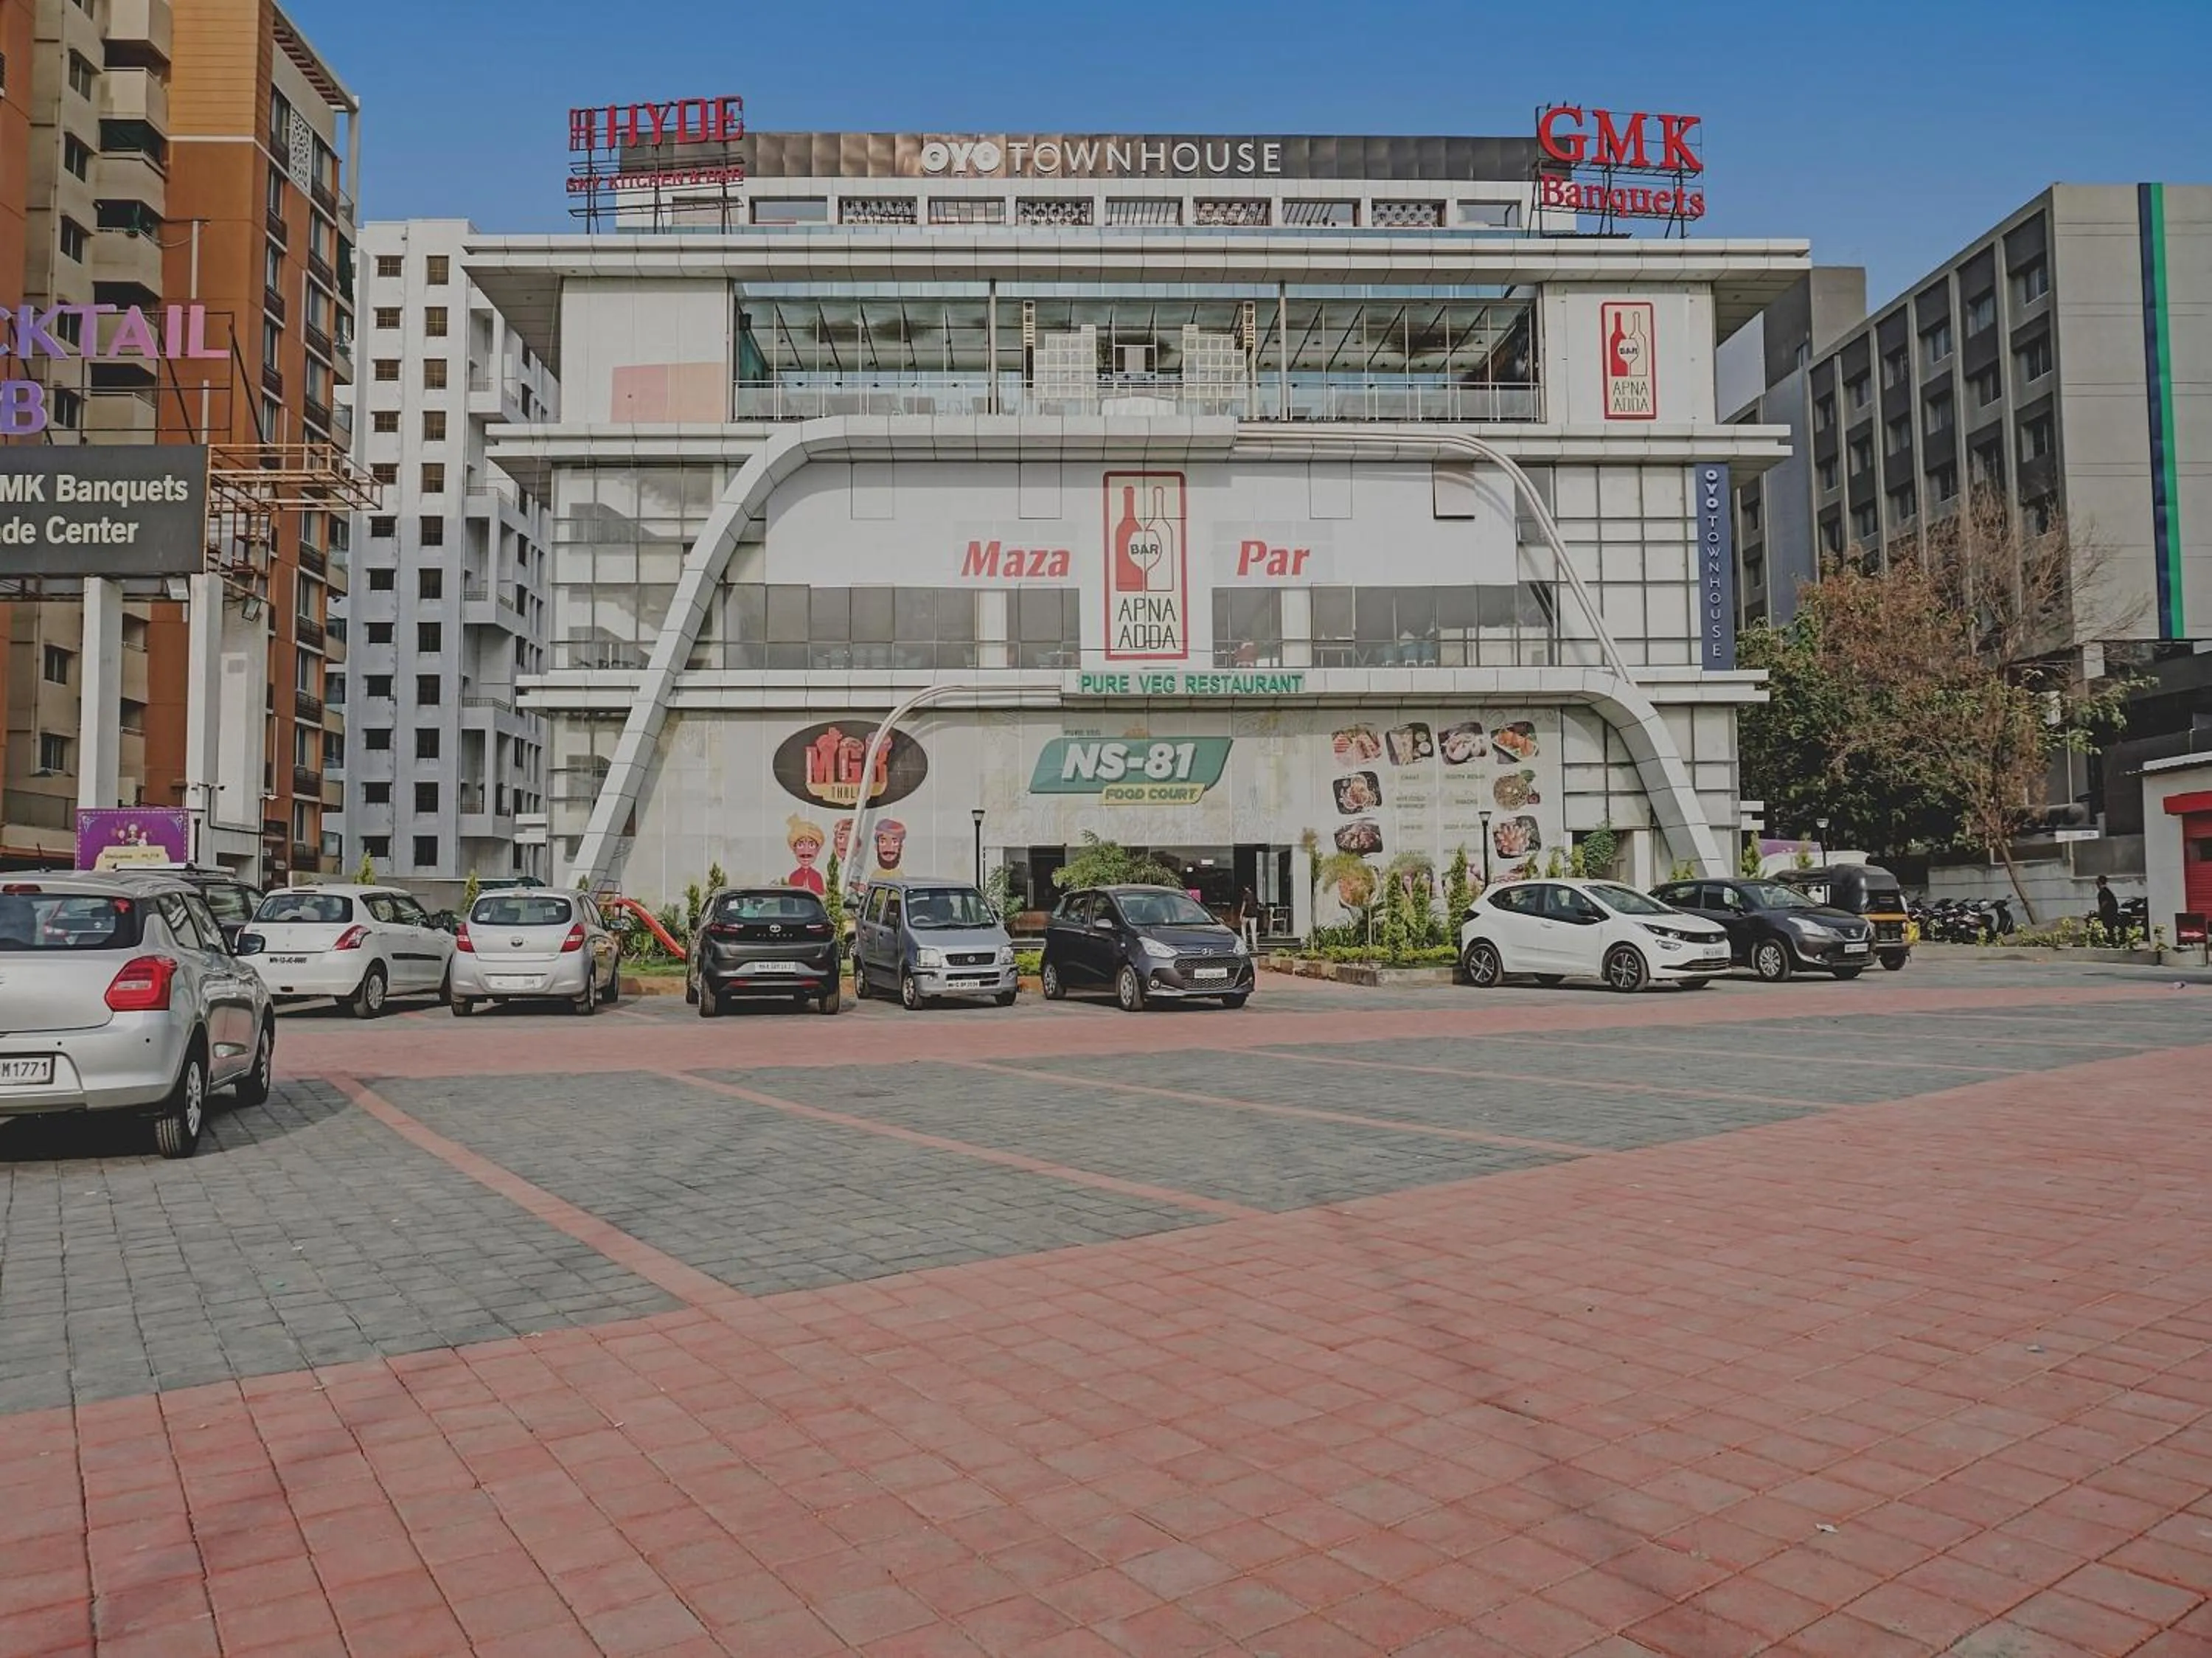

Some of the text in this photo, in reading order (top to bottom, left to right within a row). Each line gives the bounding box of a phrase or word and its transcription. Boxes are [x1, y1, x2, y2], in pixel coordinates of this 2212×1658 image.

[1538, 106, 1703, 171] GMK
[921, 142, 1281, 173] OYO TOWNHOUSE
[1540, 173, 1705, 218] Banquets
[56, 474, 188, 508] Banquets
[0, 516, 139, 544] de Center
[961, 541, 1071, 577] Maza
[1130, 543, 1160, 556] BAR
[1237, 540, 1310, 577] Par
[1118, 598, 1177, 622] APNA
[1118, 625, 1177, 650] ADDA
[1080, 674, 1304, 693] PURE VEG RESTAURANT
[1061, 742, 1197, 782] NS-81
[1105, 787, 1198, 799] FOOD COURT
